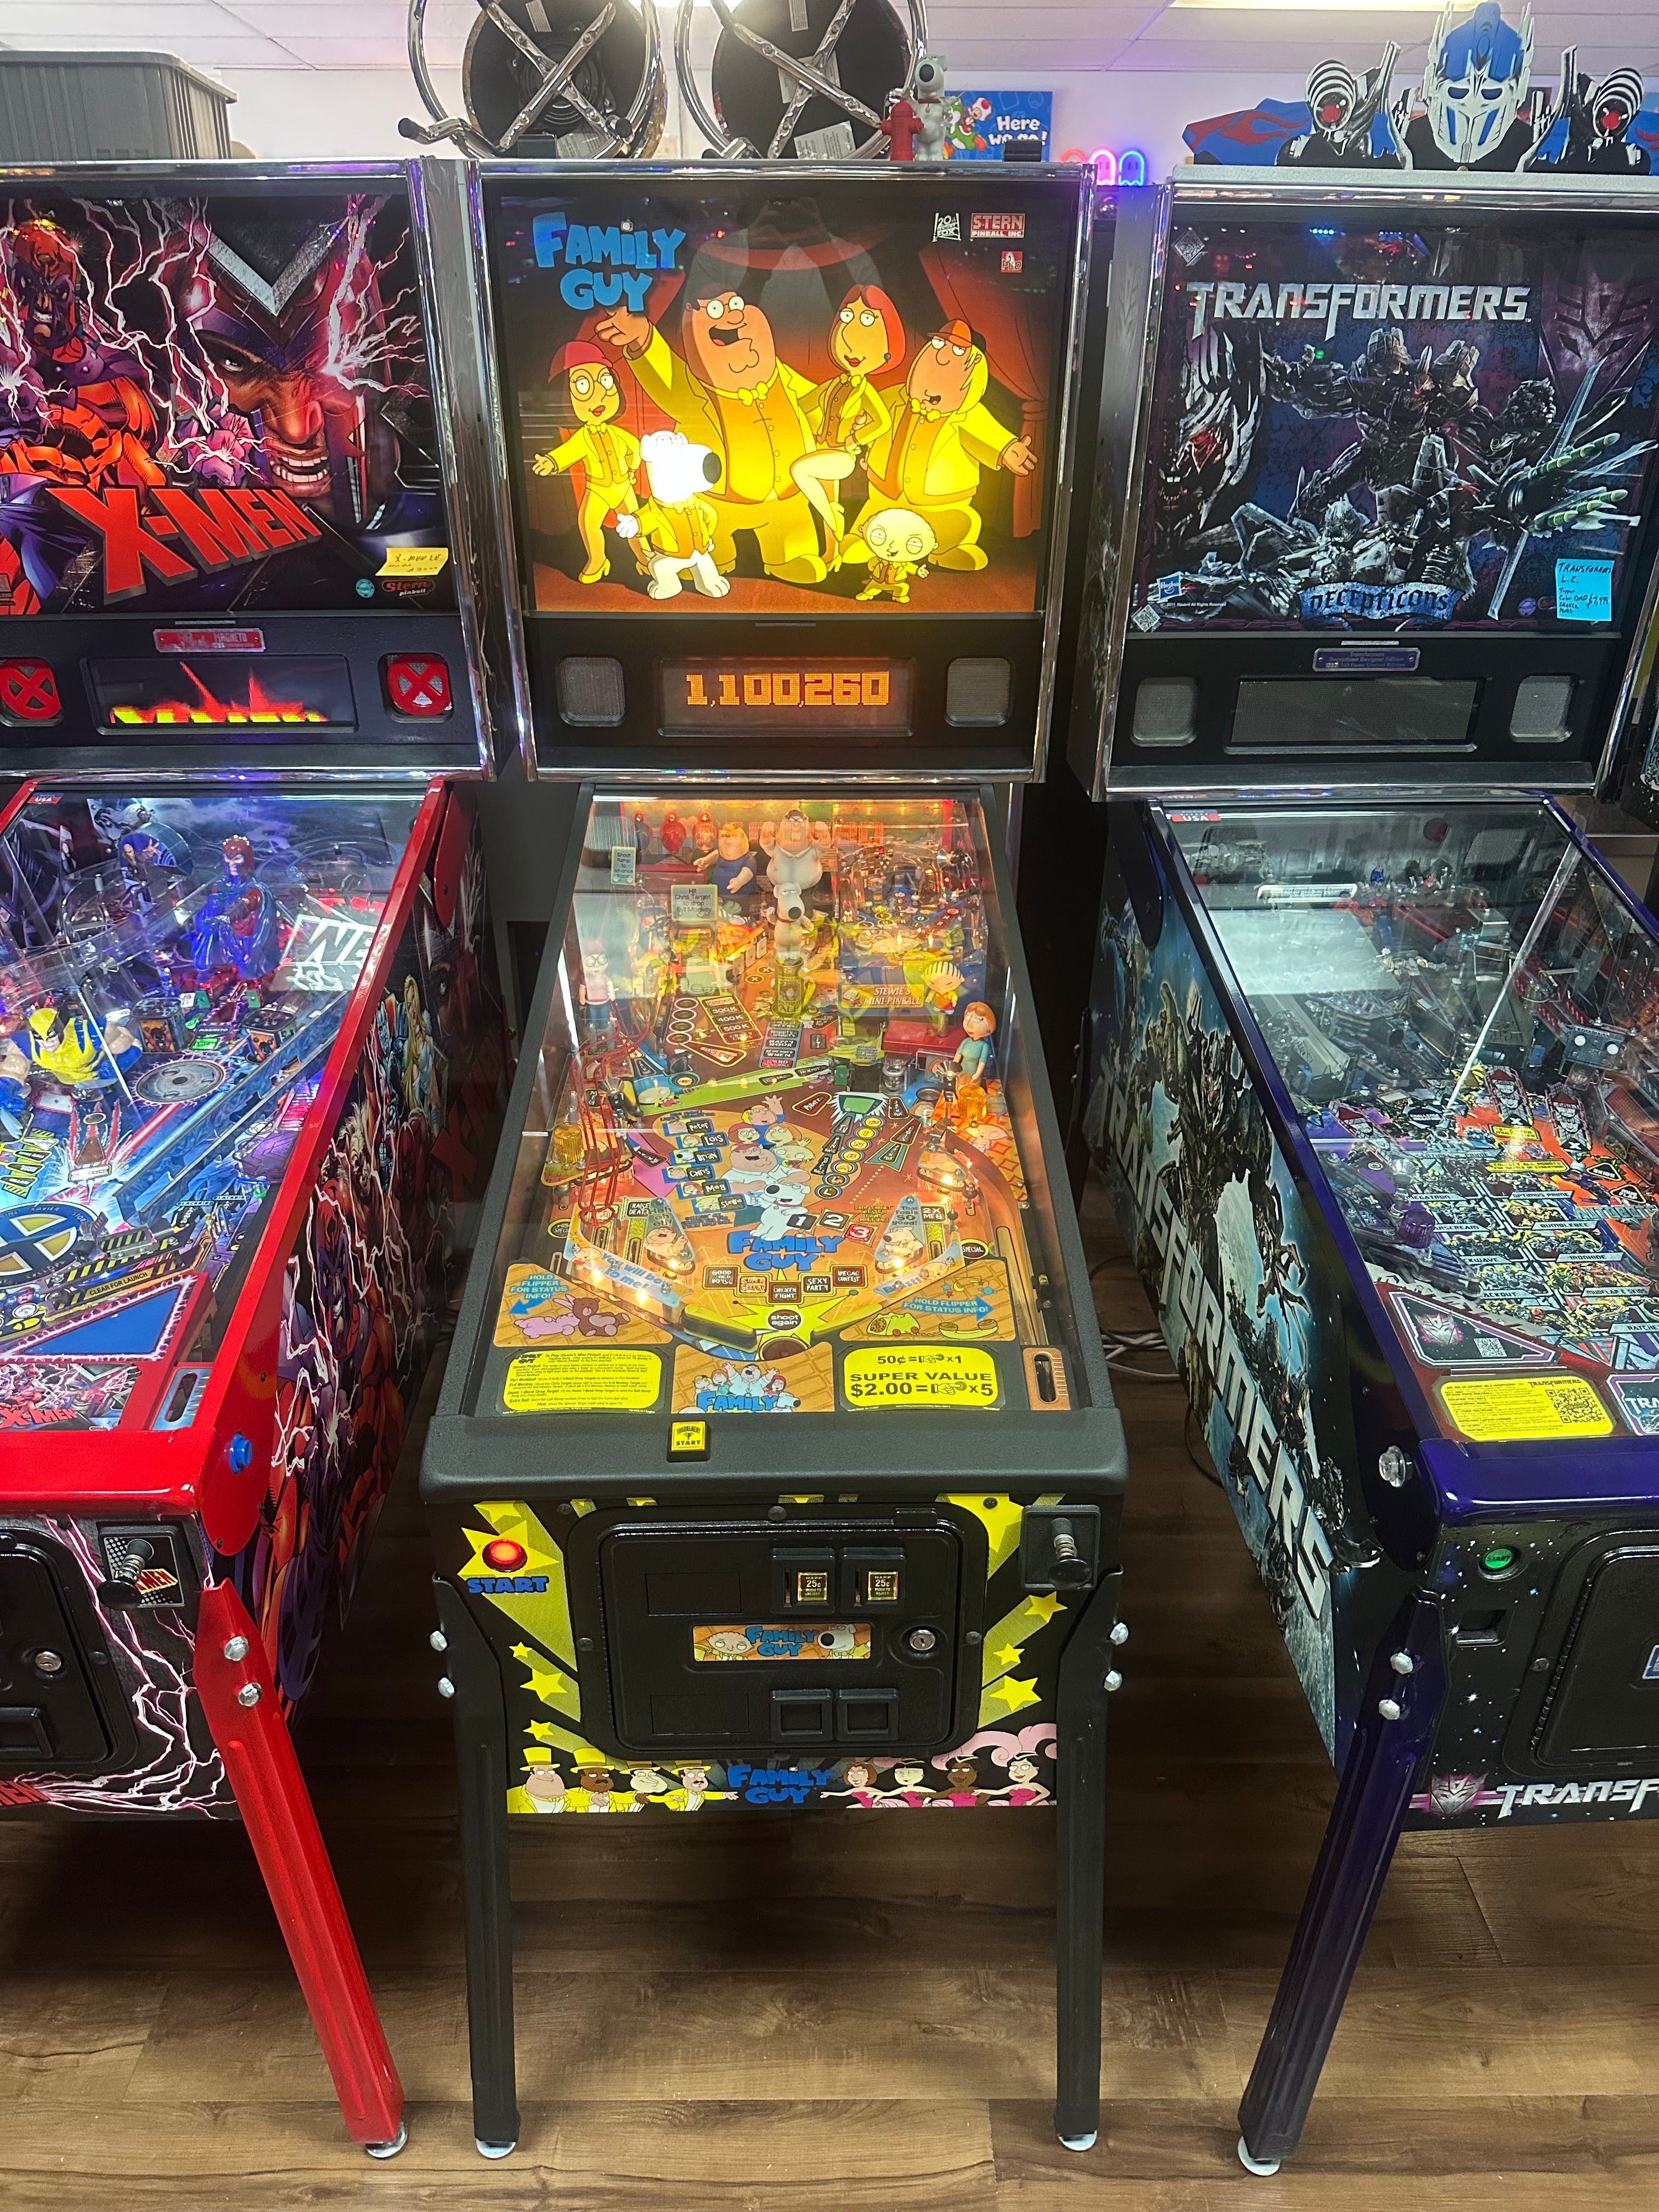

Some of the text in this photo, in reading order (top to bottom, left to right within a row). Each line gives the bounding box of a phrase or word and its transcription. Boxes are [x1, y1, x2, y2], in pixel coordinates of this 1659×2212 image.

[996, 115, 1041, 132] Here
[973, 215, 1023, 229] STERN
[532, 212, 686, 269] FAMILY
[560, 268, 653, 312] GUY
[1186, 282, 1531, 342] TRANSFORMERS
[45, 487, 323, 606] X-MEN
[386, 580, 428, 591] Stern
[399, 588, 426, 596] pinball
[873, 987, 911, 996] STEWIE'S
[863, 997, 921, 1006] MINI-PINBALL
[803, 1097, 822, 1111] PIRATE
[839, 1124, 848, 1133] TV
[1593, 1168, 1615, 1178] SKIDS
[705, 1182, 727, 1192] Meg
[795, 1214, 870, 1240] 1 2 3
[743, 1252, 820, 1271] GUY
[624, 1262, 647, 1277] will
[89, 1272, 148, 1296] CLEAR FOR LAUNCH
[620, 1274, 650, 1289] me!
[903, 1302, 924, 1311] FOR
[914, 1297, 939, 1306] HOLD
[1098, 1059, 1334, 1620] TRANSFORMERS
[850, 1372, 992, 1381] SUPER VALUE
[1528, 1380, 1582, 1389] TRANSFORMERS
[697, 1391, 779, 1412] FAMILY
[0, 1409, 78, 1427] X-MEN
[676, 1425, 701, 1434] TOURNAMENT
[1486, 1555, 1511, 1563] START
[467, 1576, 549, 1594] START
[745, 1625, 820, 1644] FAMILY
[757, 1643, 803, 1657] GUY
[727, 1764, 835, 1788] FAMILY
[744, 1785, 811, 1804] GUY
